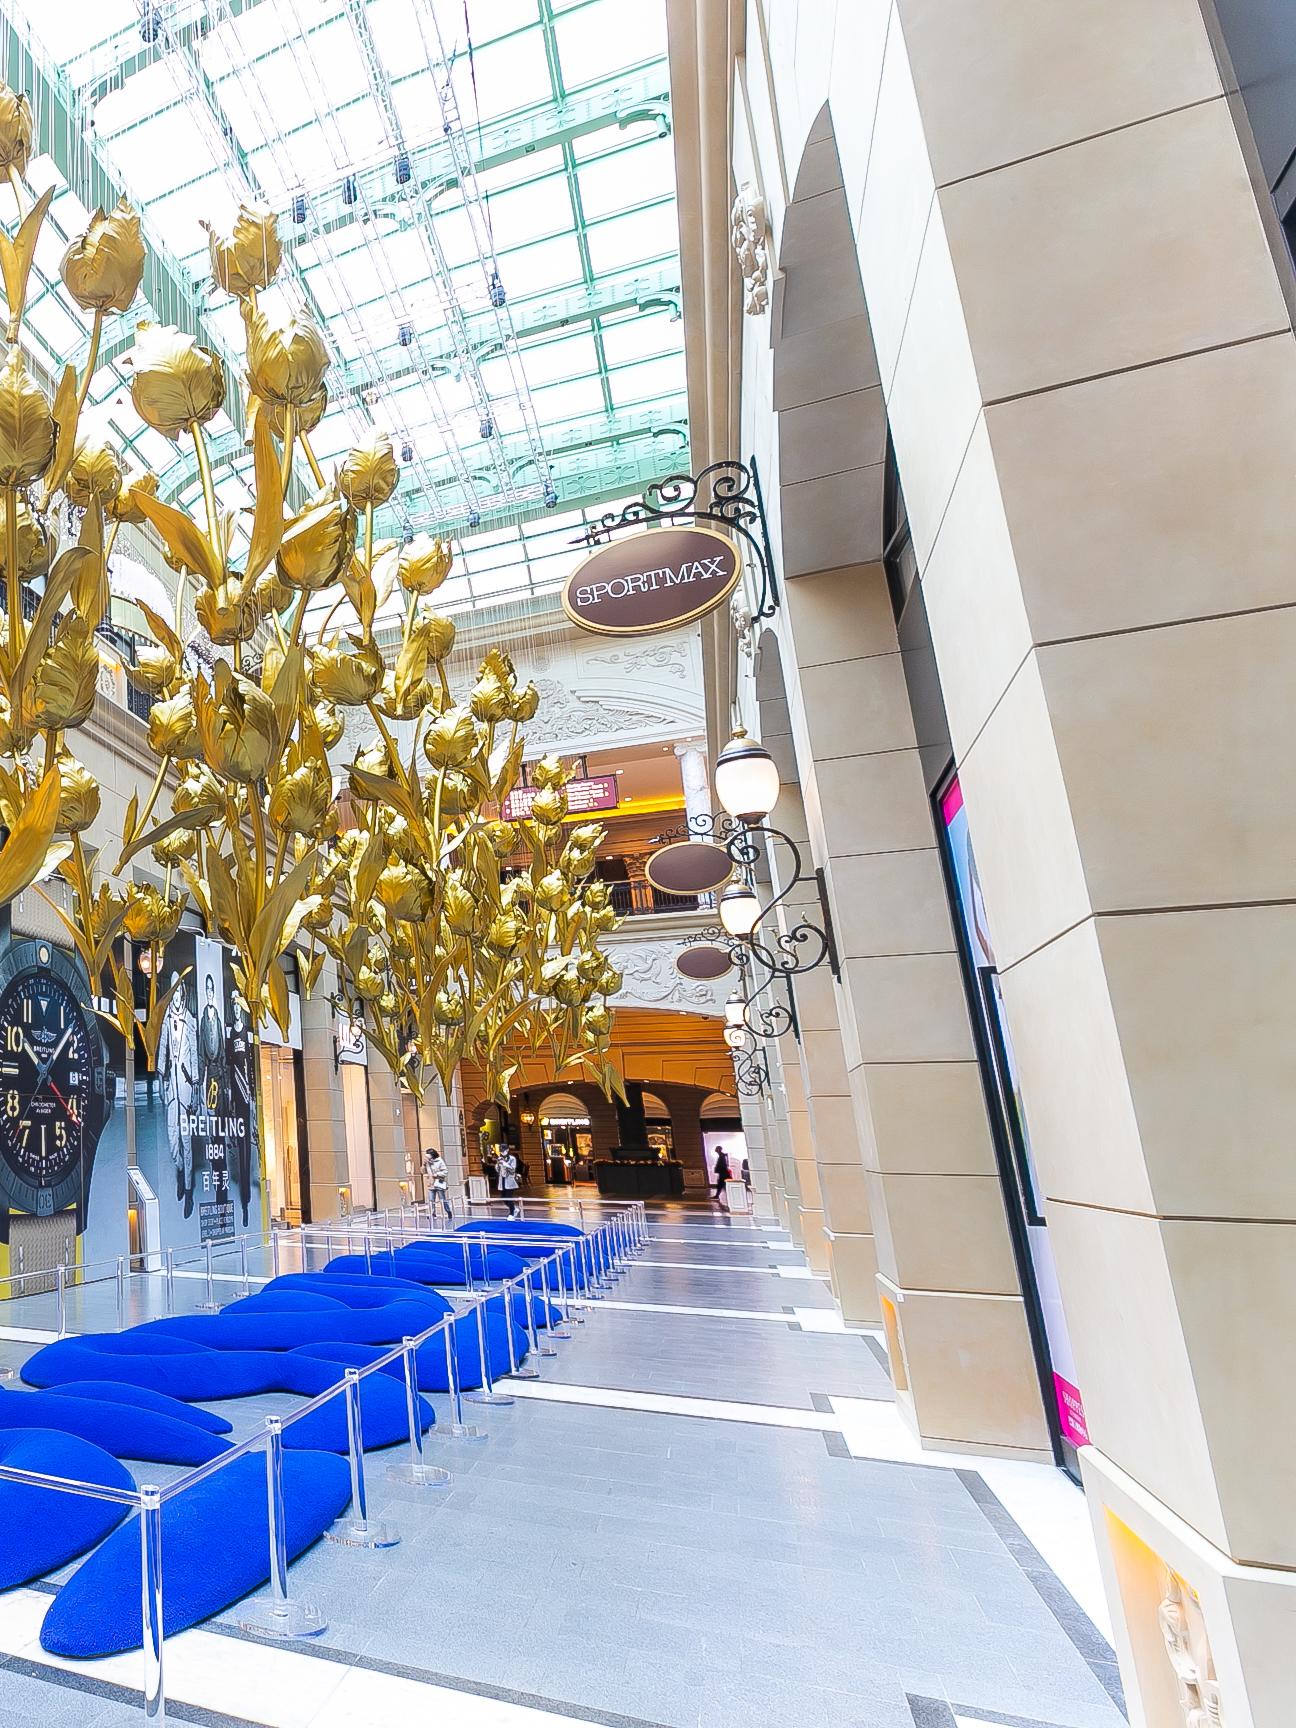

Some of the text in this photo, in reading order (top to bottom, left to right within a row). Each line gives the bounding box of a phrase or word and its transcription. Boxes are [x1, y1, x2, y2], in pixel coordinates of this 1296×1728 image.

[576, 555, 728, 607] SPORTMAX
[7, 1025, 24, 1053] 10
[6, 1089, 20, 1118] 8
[20, 1120, 32, 1148] 7
[55, 1121, 67, 1148] 5
[180, 1115, 246, 1138] BREITLING
[205, 1143, 225, 1160] 1884
[201, 1170, 230, 1192] 百年灵
